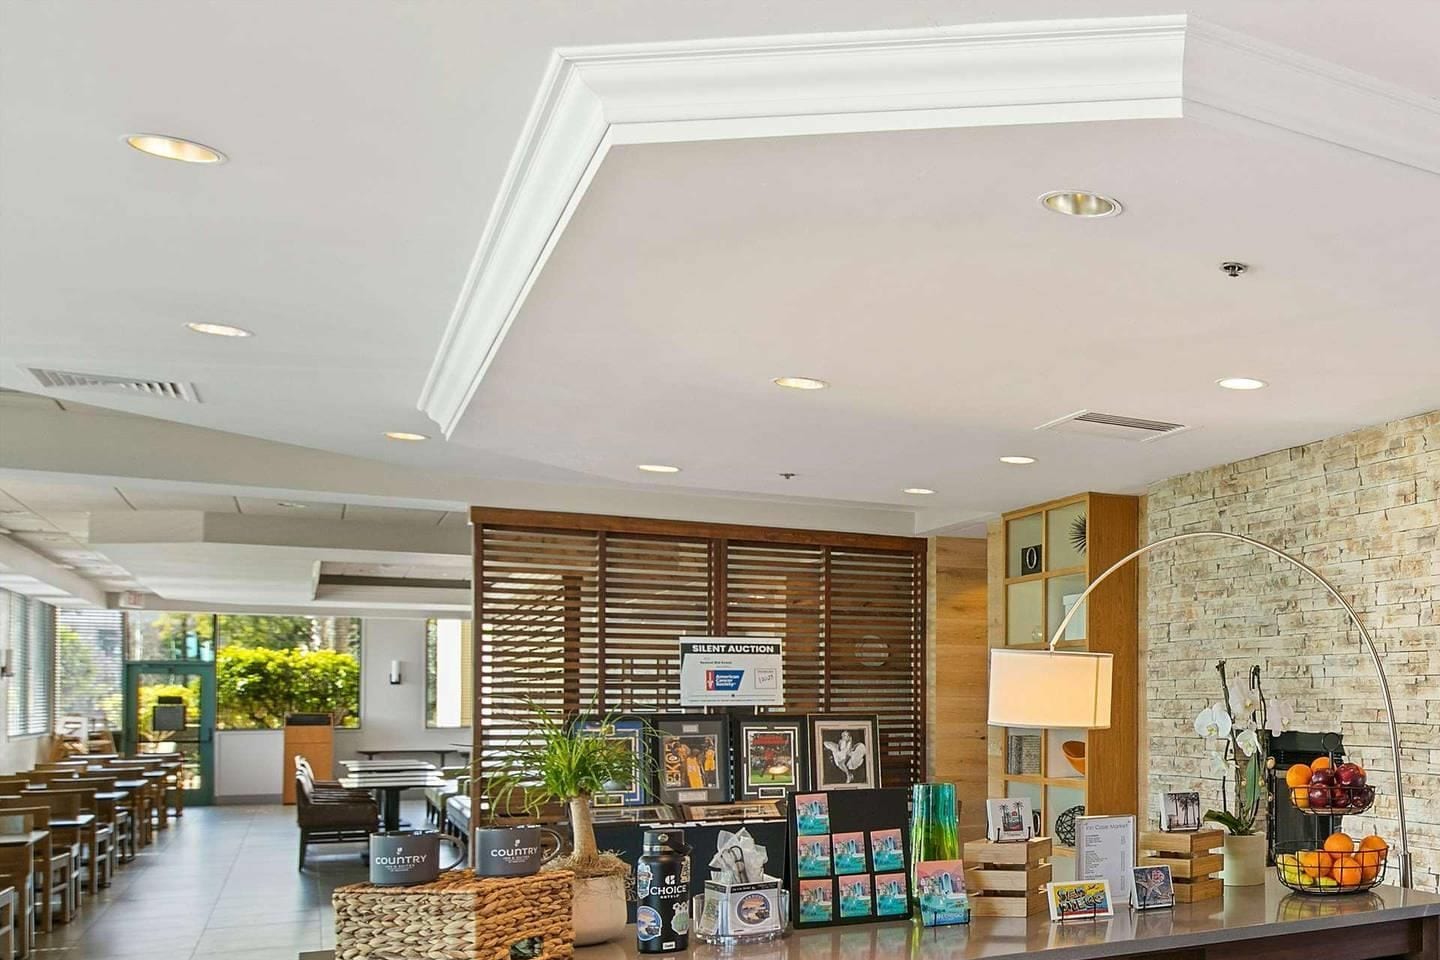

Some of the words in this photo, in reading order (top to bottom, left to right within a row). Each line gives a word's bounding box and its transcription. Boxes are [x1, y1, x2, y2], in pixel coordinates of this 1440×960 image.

[692, 644, 727, 653] SILENT
[727, 645, 774, 653] AUCTION
[650, 886, 687, 895] CHOICE
